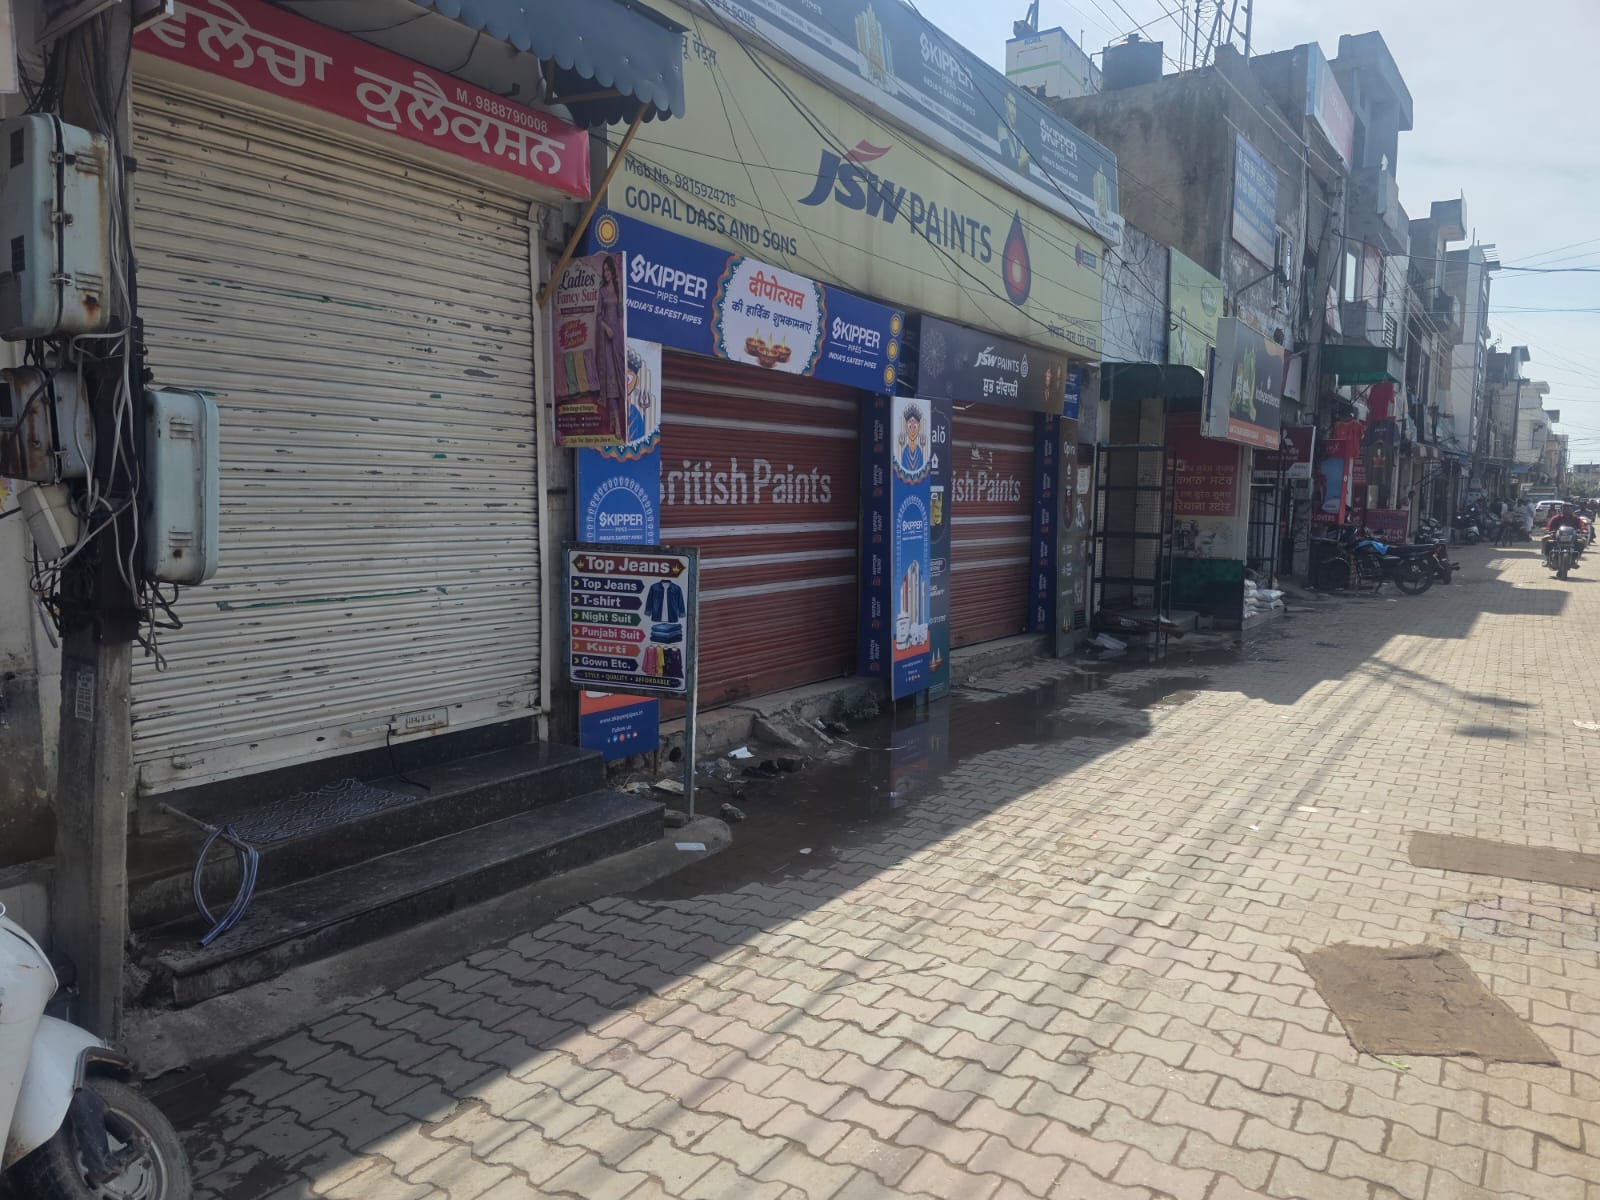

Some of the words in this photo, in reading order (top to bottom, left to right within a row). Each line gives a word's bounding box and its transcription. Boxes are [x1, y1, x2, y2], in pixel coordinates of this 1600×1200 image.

[919, 31, 974, 91] SKIPPER
[456, 87, 472, 106] M.
[475, 95, 548, 134] 9888790008
[624, 158, 651, 178] Mob
[653, 166, 672, 185] No.
[674, 174, 736, 208] 9815924215
[797, 148, 907, 225] JSW
[909, 191, 992, 263] PAINTS
[624, 186, 682, 221] GOPAL
[685, 204, 726, 235] DASS
[729, 220, 760, 245] AND
[762, 229, 797, 256] SONS
[558, 270, 596, 290] Ladies
[630, 254, 708, 300] SKIPPER
[557, 291, 579, 305] Fancy
[581, 288, 598, 301] Suit
[656, 290, 679, 304] PIPES
[748, 270, 806, 310] दीपोत्सव
[653, 306, 682, 320] SAFEST
[681, 313, 703, 325] PIPES
[731, 298, 744, 313] की
[745, 303, 771, 319] हार्दिक
[831, 316, 881, 350] SKIPPER
[847, 344, 862, 354] PIPES
[846, 357, 864, 366] SAFEST
[973, 351, 998, 368] JSW
[997, 356, 1020, 373] PAINTS
[660, 457, 747, 505] ritish
[752, 458, 832, 504] Paints
[977, 471, 1021, 502] Paints
[599, 511, 643, 528] SKIPPER
[585, 555, 614, 574] Top
[618, 557, 670, 575] Jeans
[582, 578, 603, 591] Top
[604, 580, 637, 591] Jeans
[582, 594, 621, 607] T-shirt
[582, 611, 609, 624] Night
[611, 612, 632, 624] Suit
[582, 627, 618, 640] Punjabi
[620, 629, 640, 640] Suit
[586, 642, 627, 655] Kurti
[582, 657, 609, 668] Gown
[611, 659, 631, 670] Etc.
[584, 671, 601, 679] STYLE
[605, 672, 628, 681] QUALITY
[634, 676, 670, 686] AFFORDABLE
